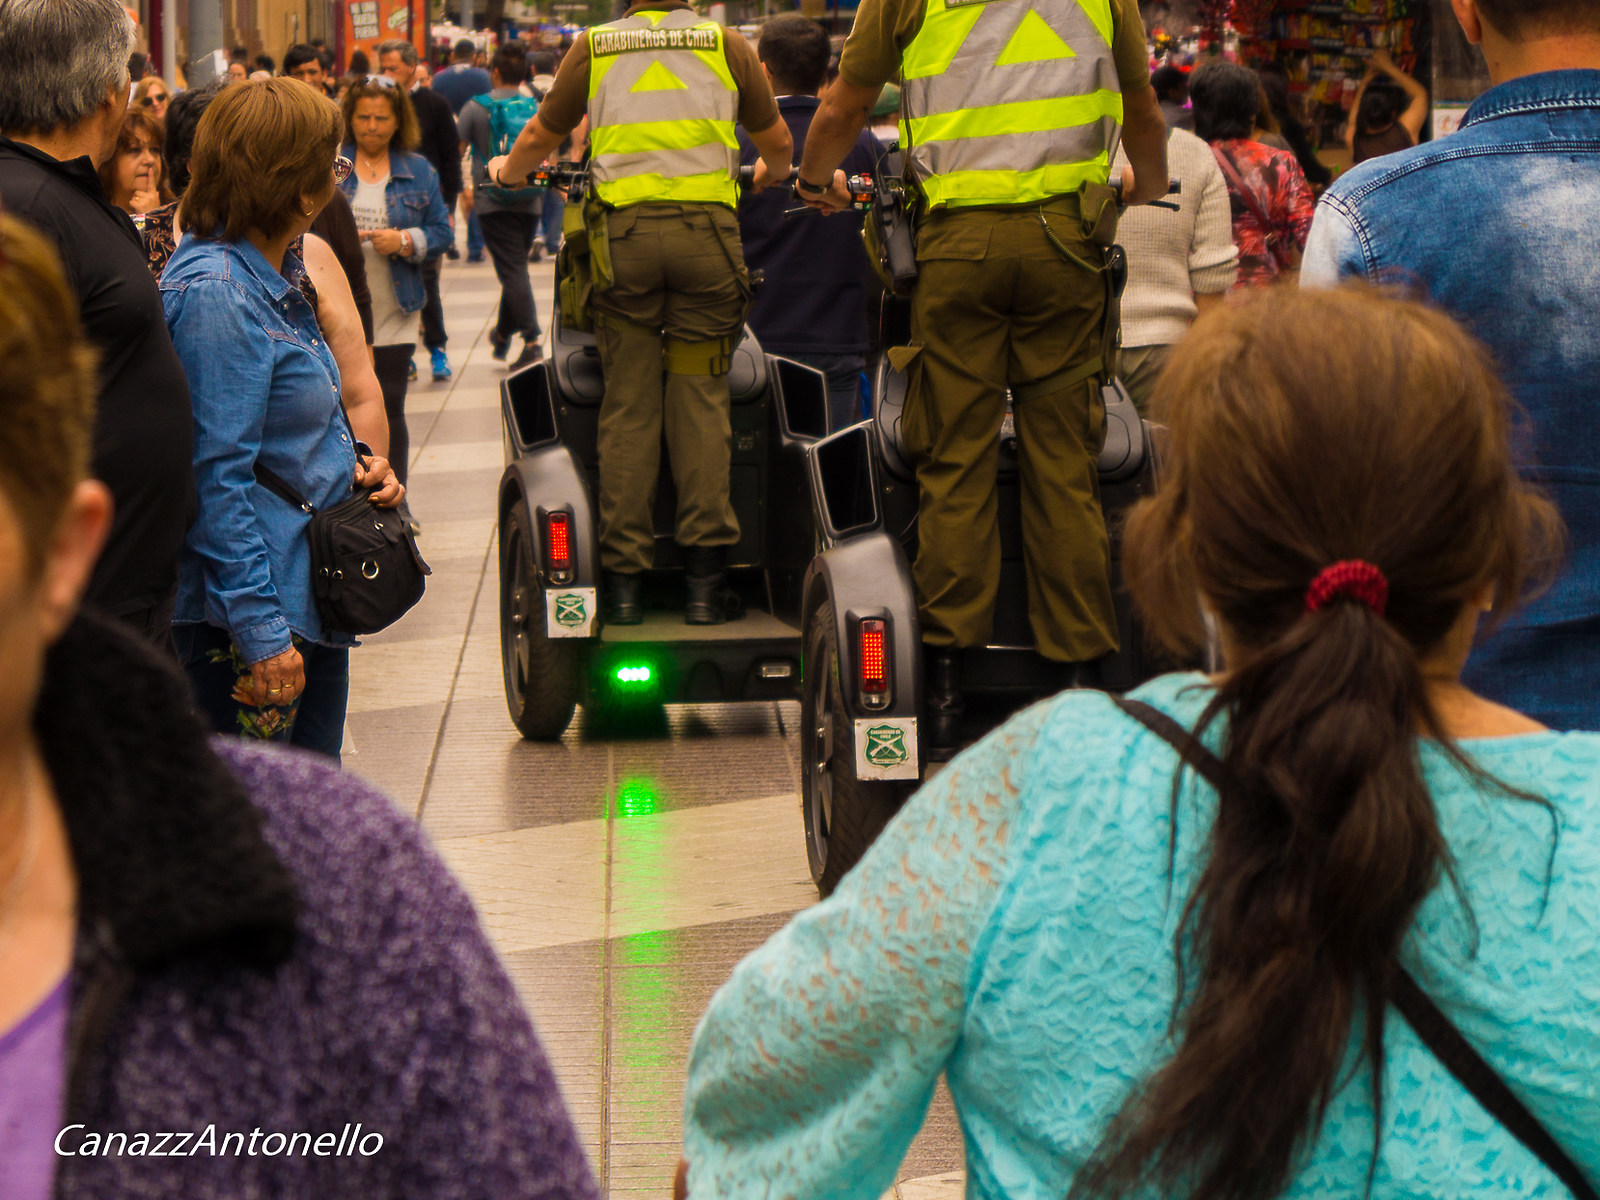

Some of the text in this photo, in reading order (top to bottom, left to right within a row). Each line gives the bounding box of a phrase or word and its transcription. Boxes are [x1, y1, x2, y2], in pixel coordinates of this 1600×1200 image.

[594, 28, 715, 54] CARABINEROS DE CHILE
